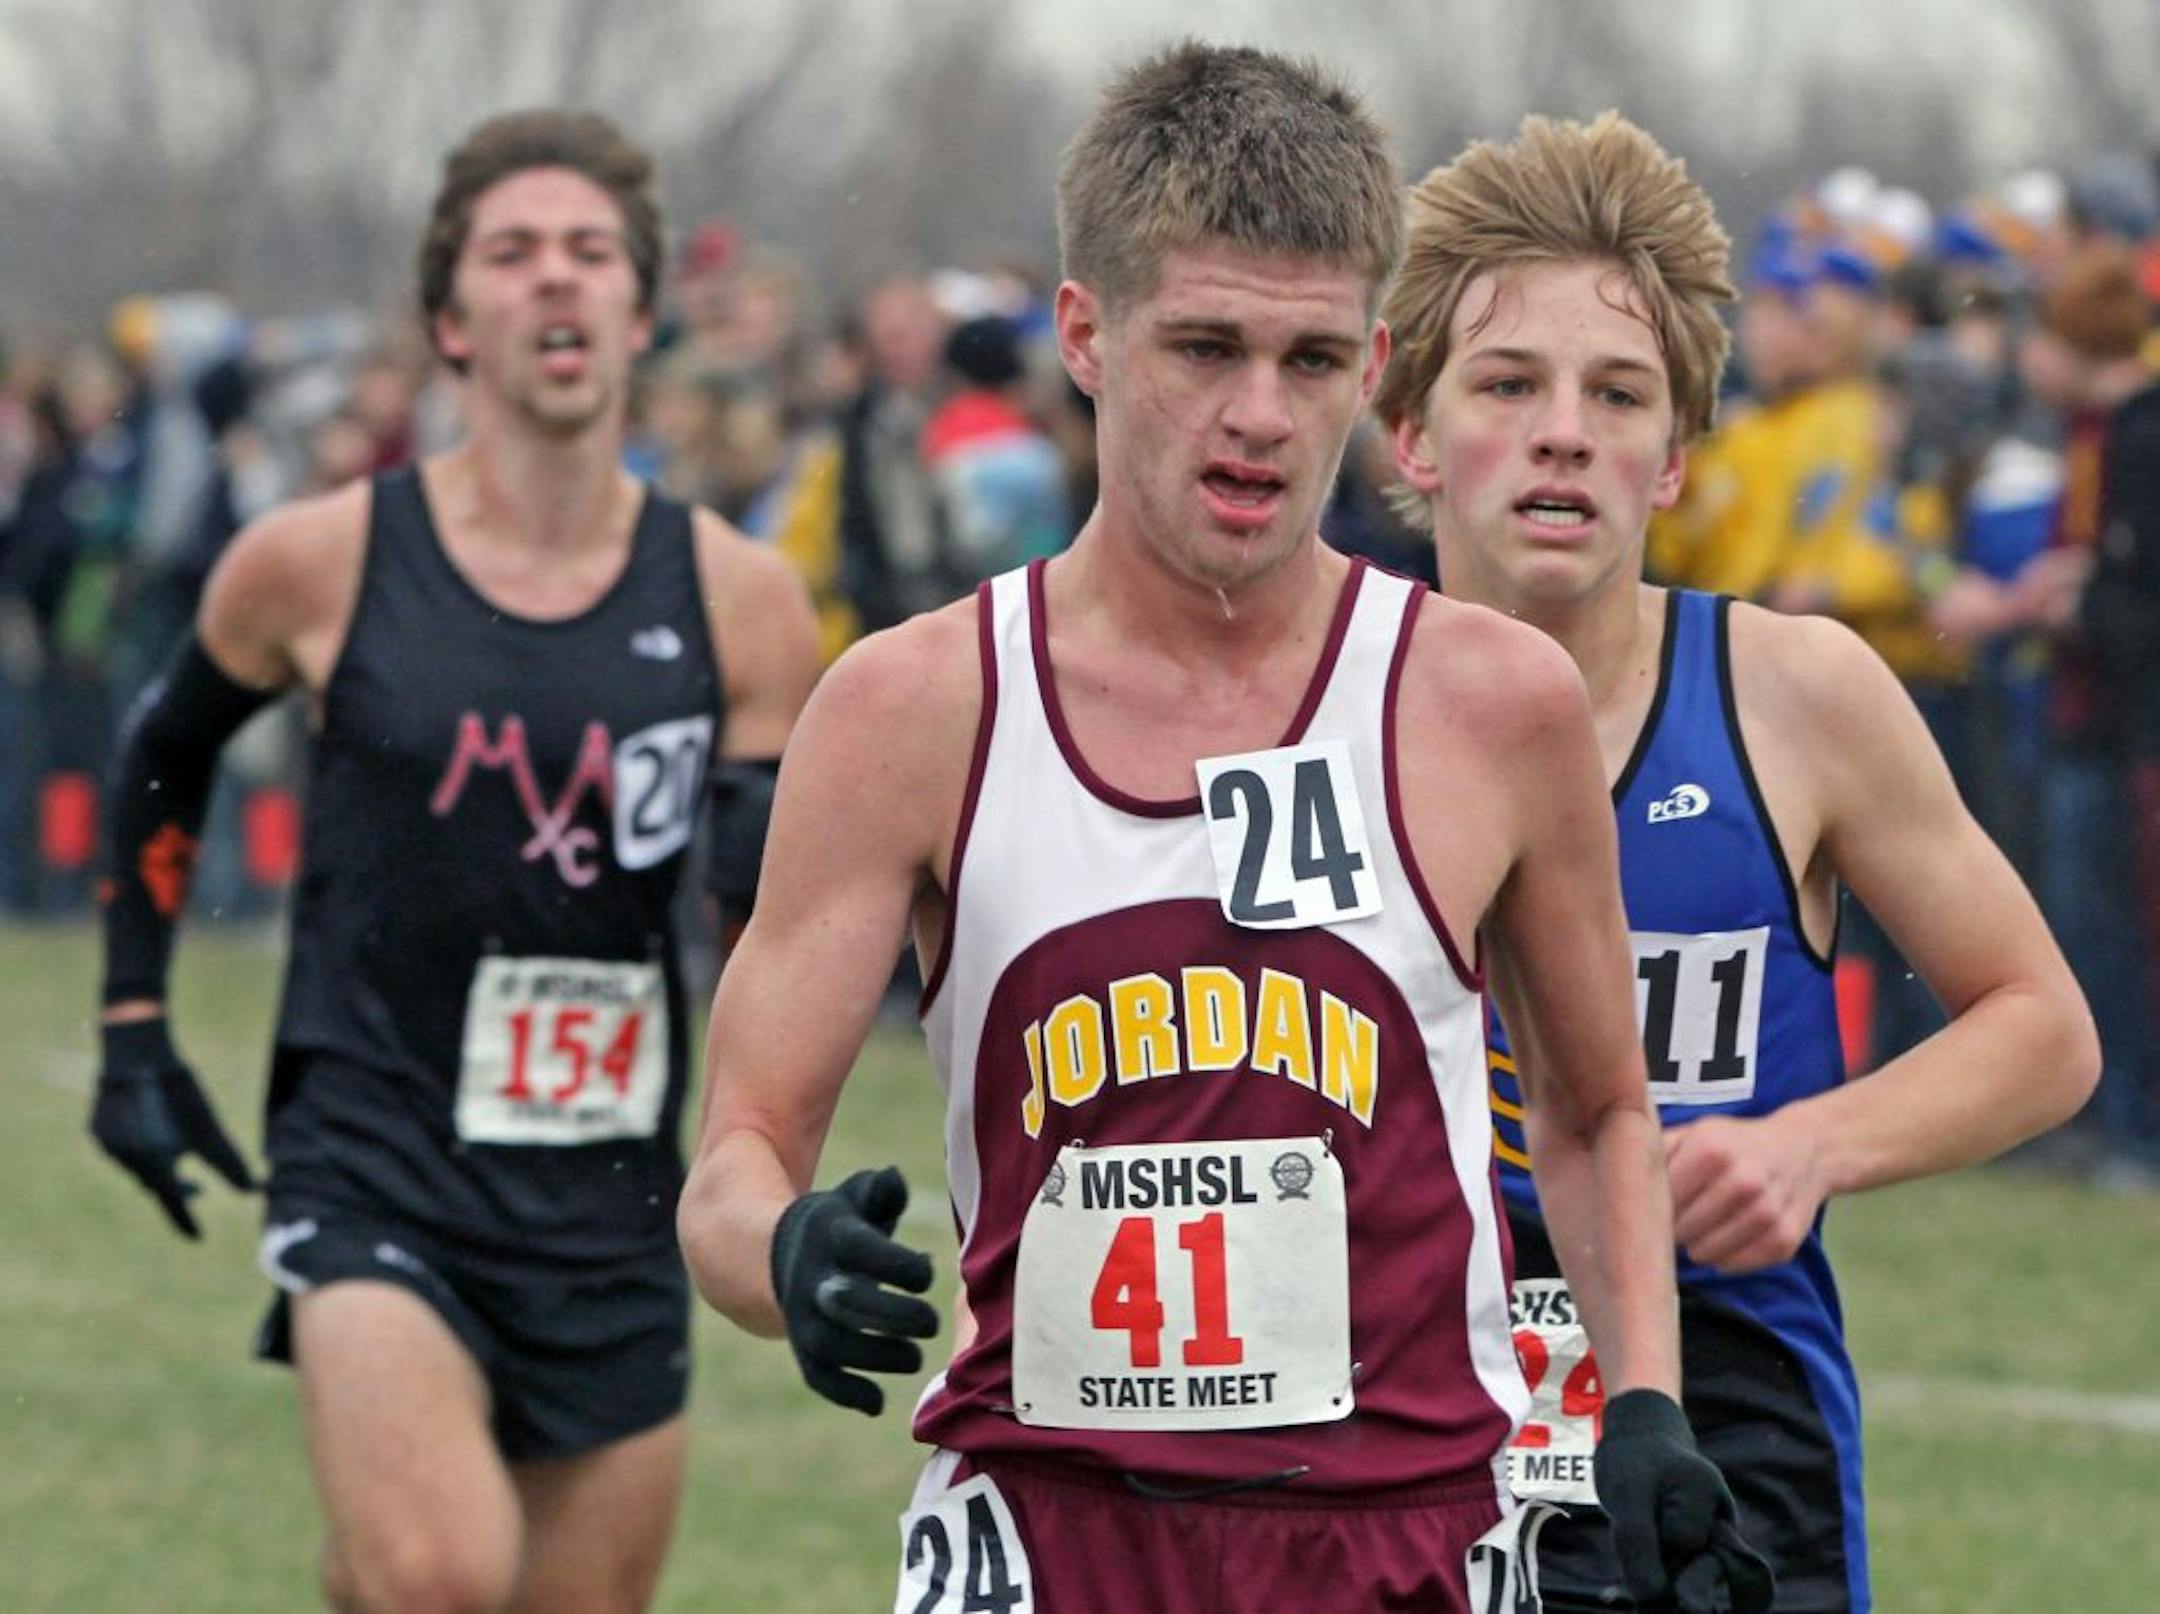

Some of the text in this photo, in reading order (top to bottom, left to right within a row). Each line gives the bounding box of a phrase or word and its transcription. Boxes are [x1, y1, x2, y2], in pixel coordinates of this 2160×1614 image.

[1209, 758, 1365, 922] 24
[496, 1008, 643, 1102] 154
[1021, 965, 1379, 1139] JORDAN
[1637, 948, 1749, 1083] 11
[1080, 1155, 1258, 1210] MSHSL
[1090, 1213, 1244, 1368] 41
[1079, 1372, 1278, 1408] STATE MEET
[1524, 1454, 1594, 1482] MEE
[907, 1492, 1024, 1614] 24
